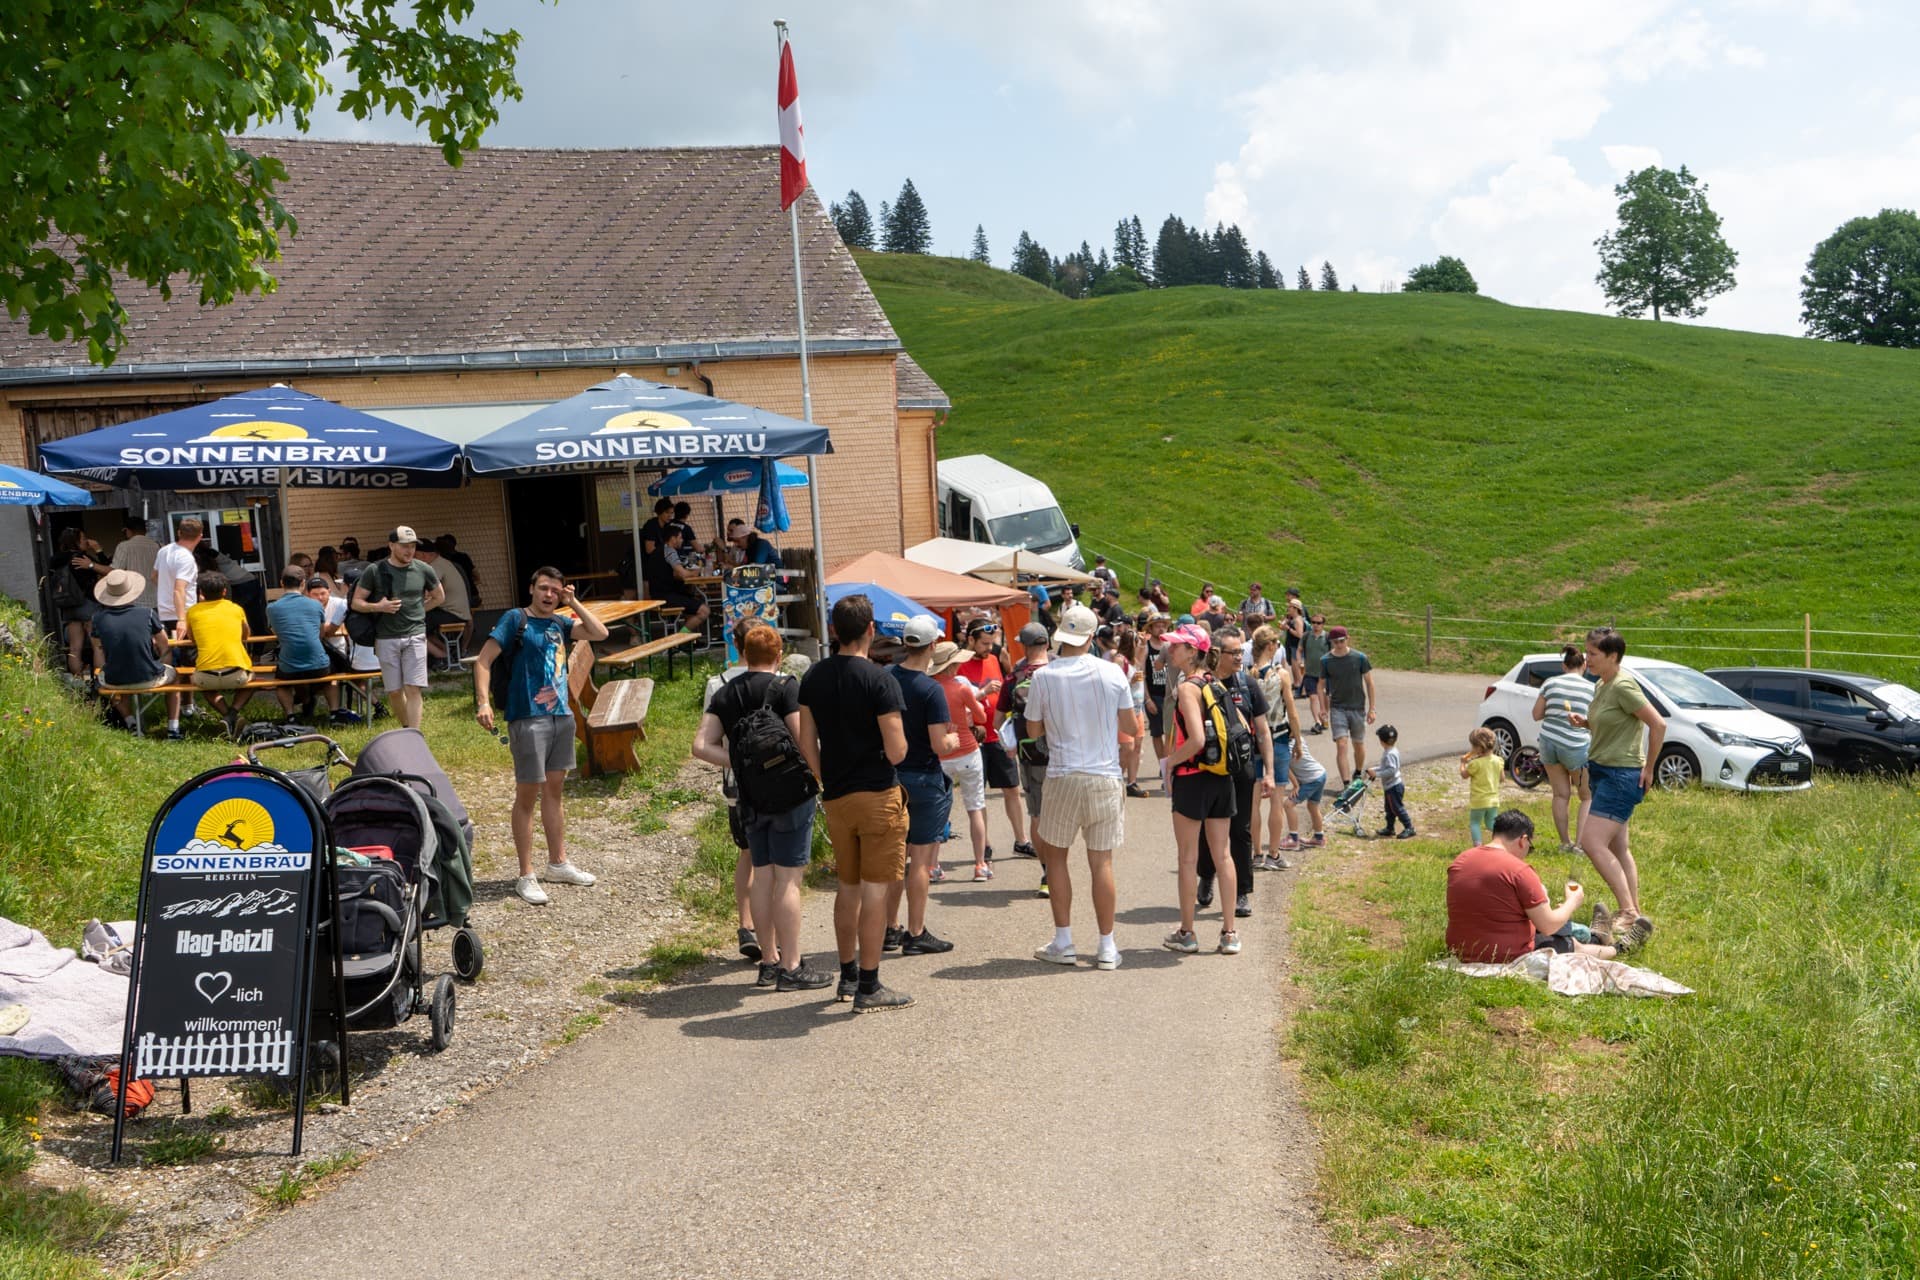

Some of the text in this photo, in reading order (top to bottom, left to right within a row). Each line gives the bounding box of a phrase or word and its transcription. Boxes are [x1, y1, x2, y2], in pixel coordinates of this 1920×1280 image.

[535, 433, 766, 461] SONNENBRÄU
[119, 446, 387, 466] SONNENBRÄU
[0, 490, 41, 498] ENBRÄU
[157, 855, 306, 870] SONNENBRÄU
[205, 873, 257, 881] REBSTEIN
[175, 928, 274, 957] Hag-Beizli
[230, 987, 263, 1002] -lich
[184, 1016, 282, 1032] willkommen!
